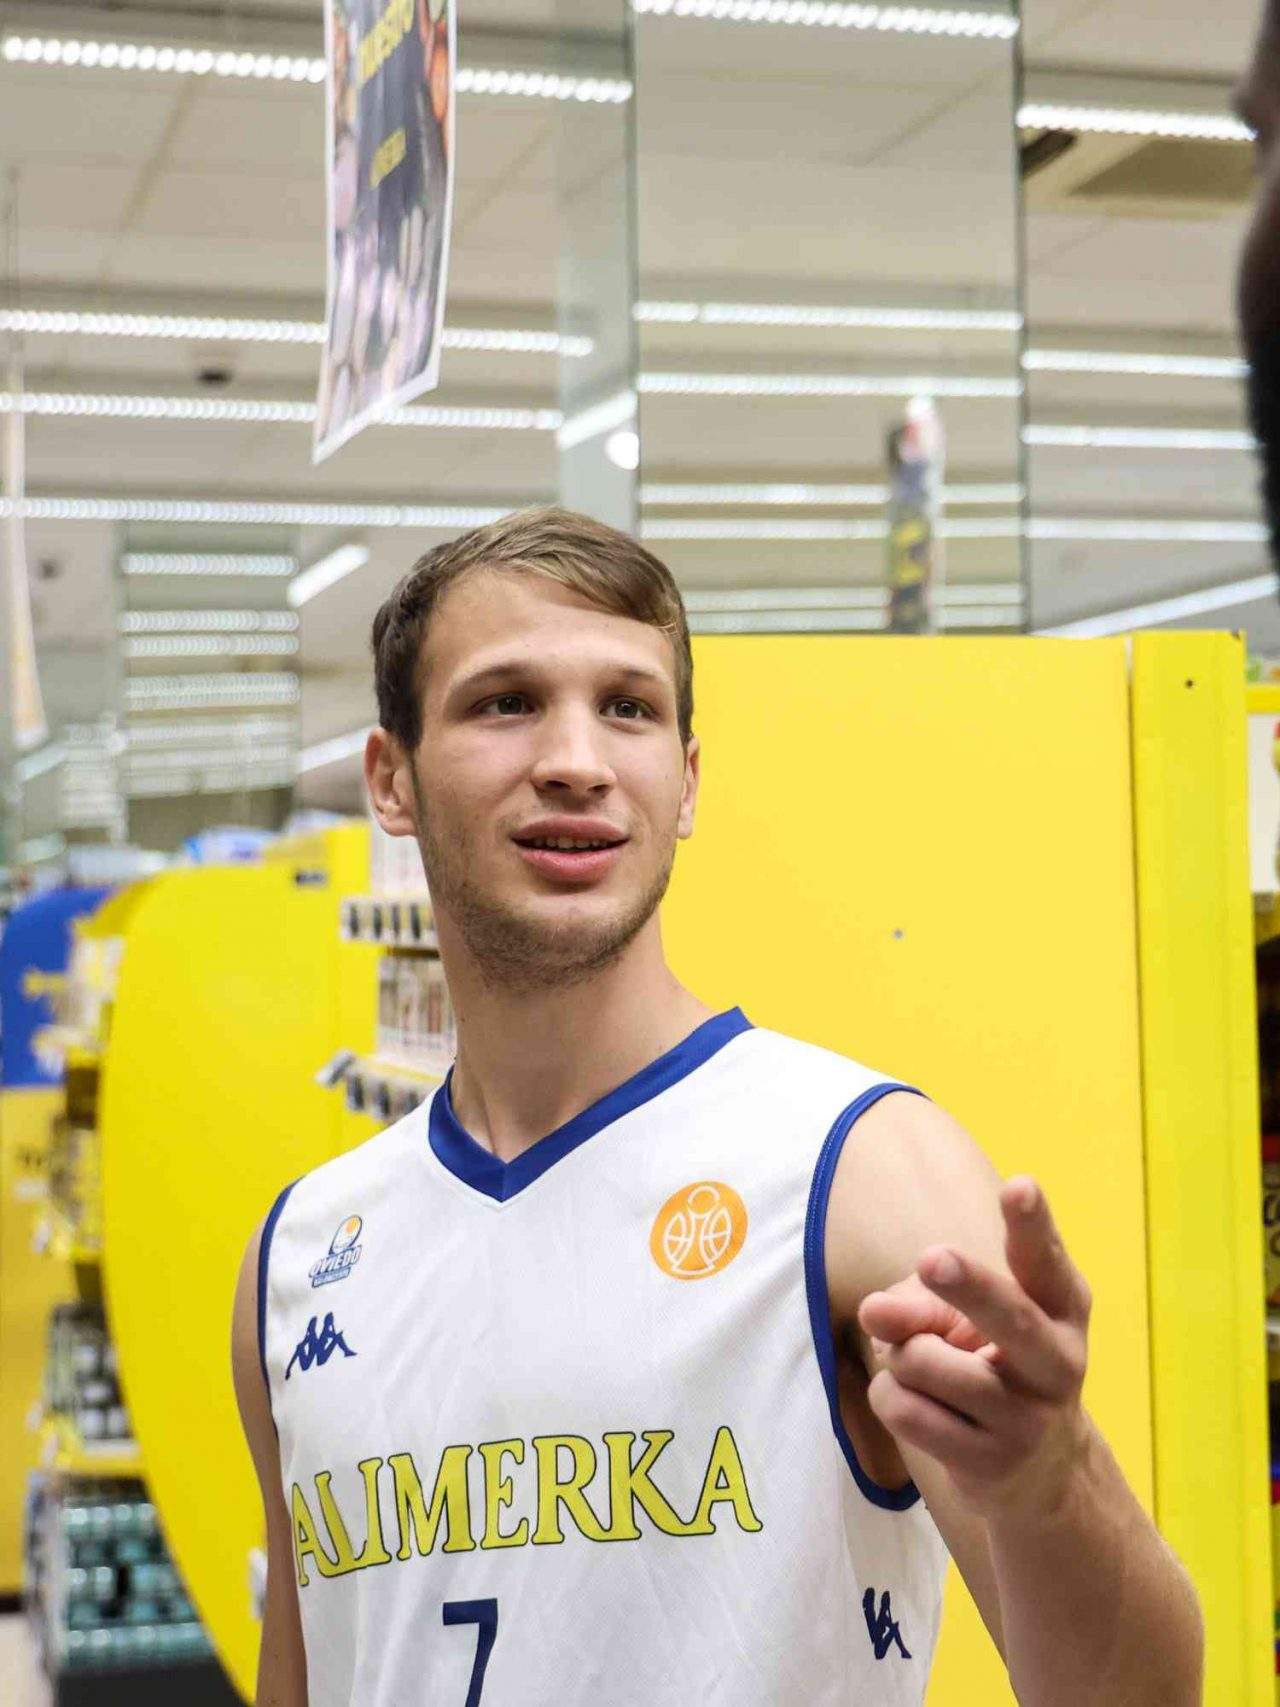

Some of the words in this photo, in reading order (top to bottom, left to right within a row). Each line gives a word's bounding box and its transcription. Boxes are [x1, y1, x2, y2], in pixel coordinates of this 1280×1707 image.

[308, 1245, 362, 1278] OVIEDO
[291, 1425, 763, 1587] ALIMERKA
[442, 1597, 498, 1707] 7
